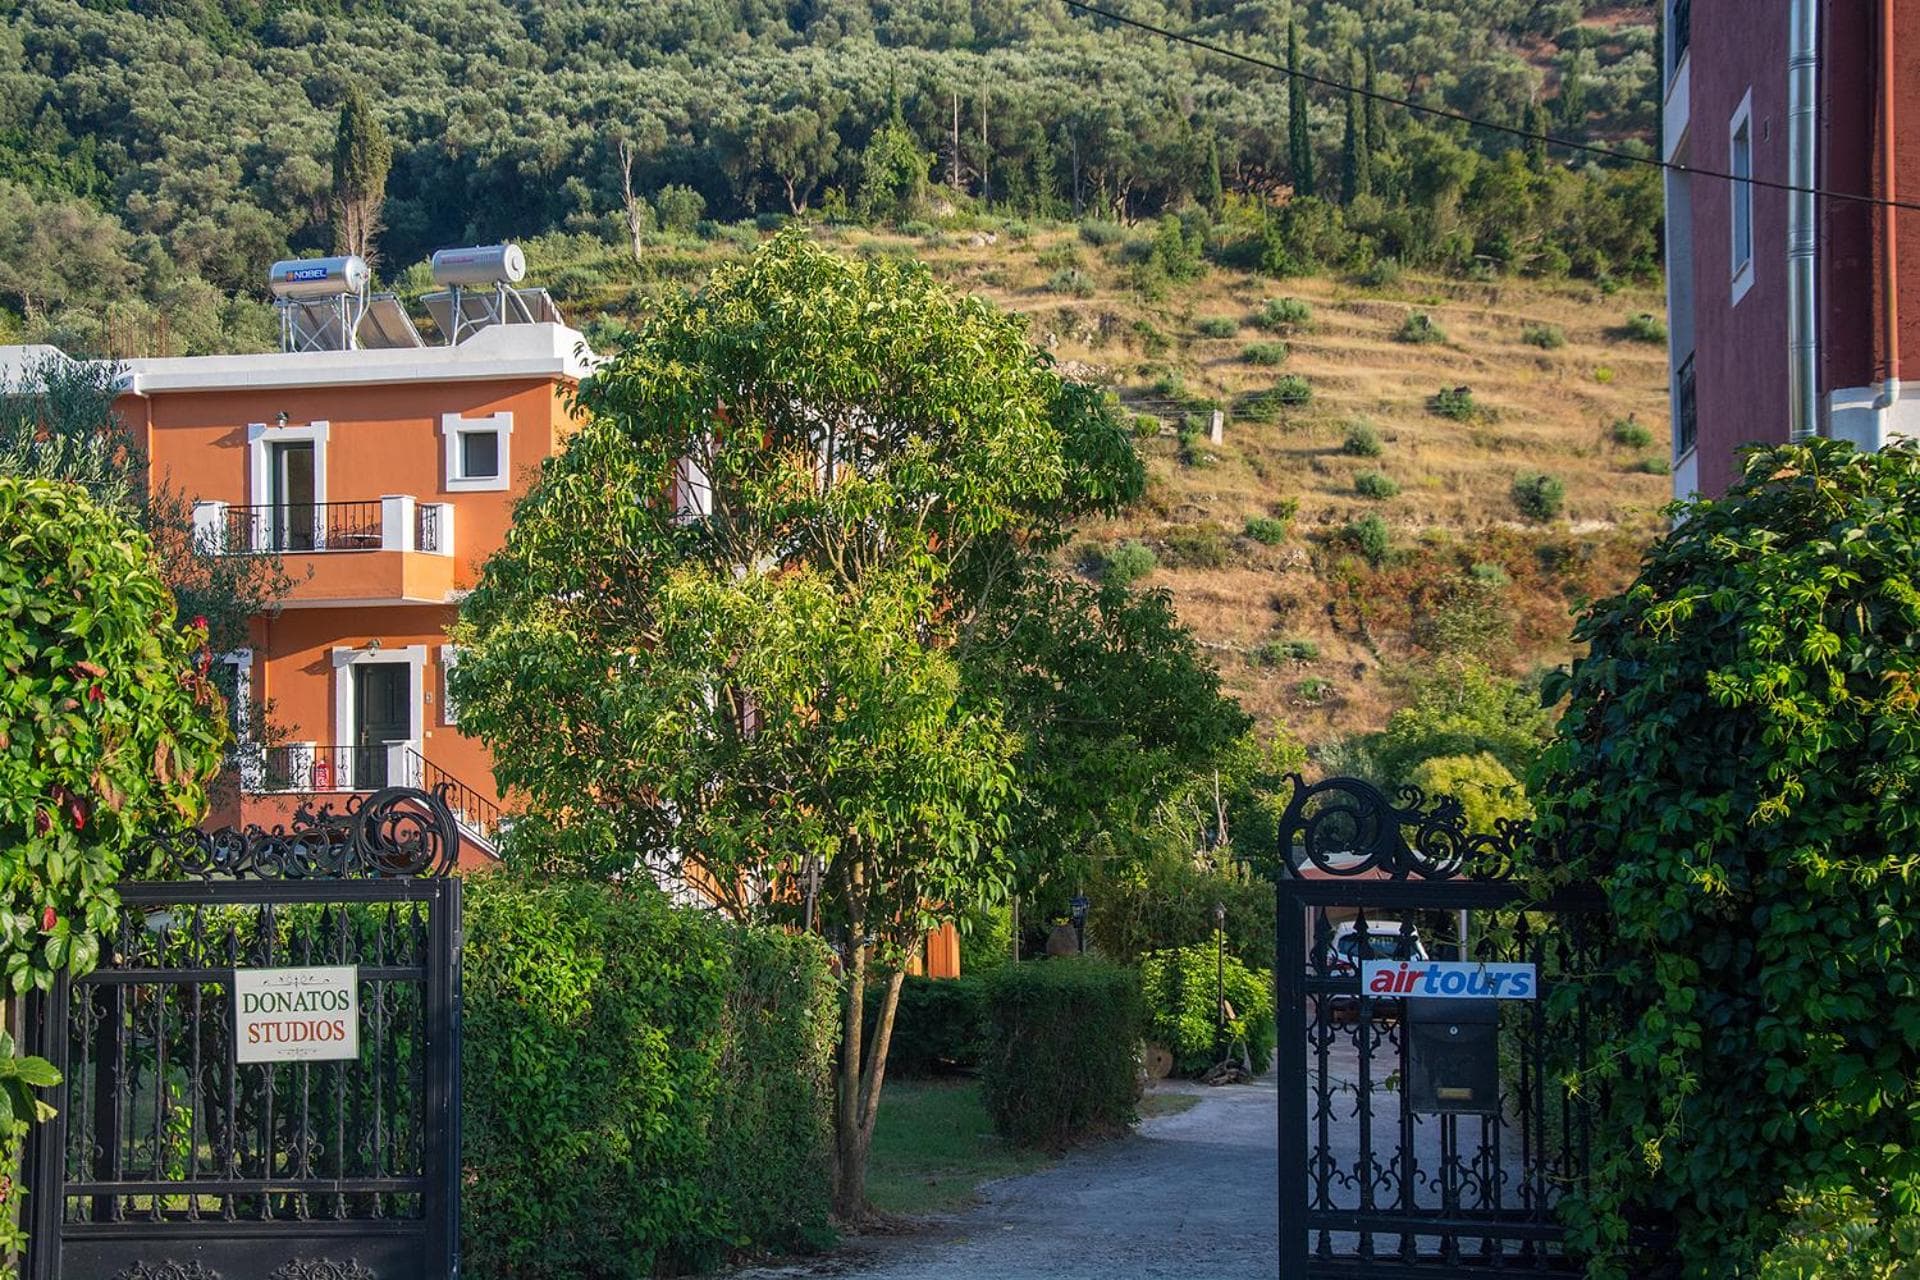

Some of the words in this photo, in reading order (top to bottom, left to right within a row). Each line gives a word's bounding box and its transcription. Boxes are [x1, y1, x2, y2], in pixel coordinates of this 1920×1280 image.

[294, 269, 327, 279] NOBEL
[1370, 962, 1532, 996] airtours
[243, 990, 350, 1013] DONATOS
[248, 1020, 345, 1044] STUDIOS
